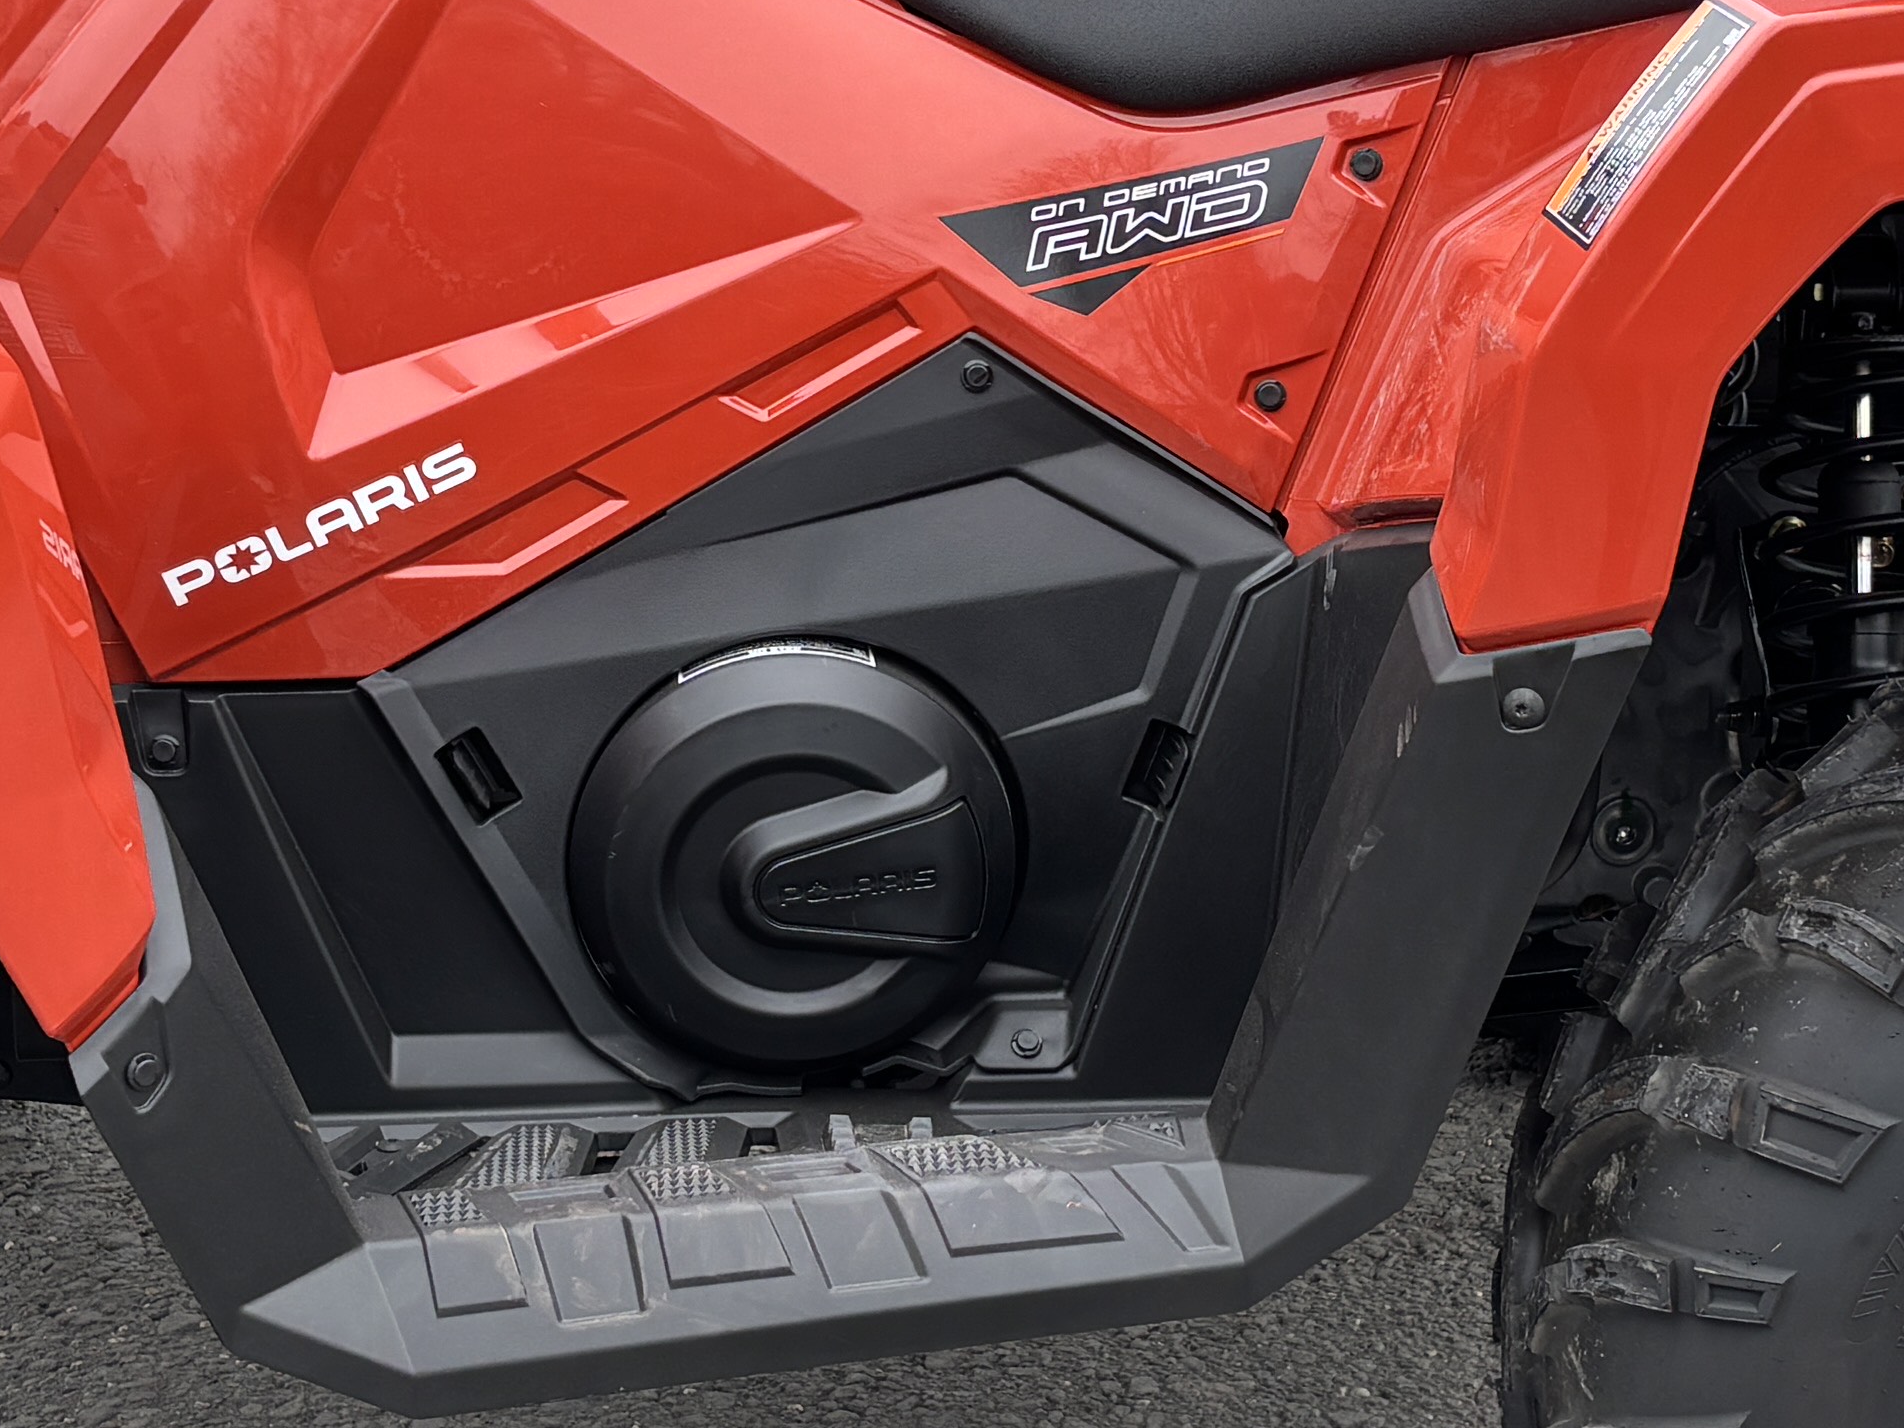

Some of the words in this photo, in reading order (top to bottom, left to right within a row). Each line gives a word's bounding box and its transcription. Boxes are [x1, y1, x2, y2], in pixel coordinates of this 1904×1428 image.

[1599, 51, 1670, 138] WARNING
[1025, 179, 1269, 272] AWD
[1030, 197, 1085, 223] ON
[1103, 157, 1271, 207] DEMAND
[160, 441, 478, 607] POLARIS
[779, 868, 937, 908] POLARIS
